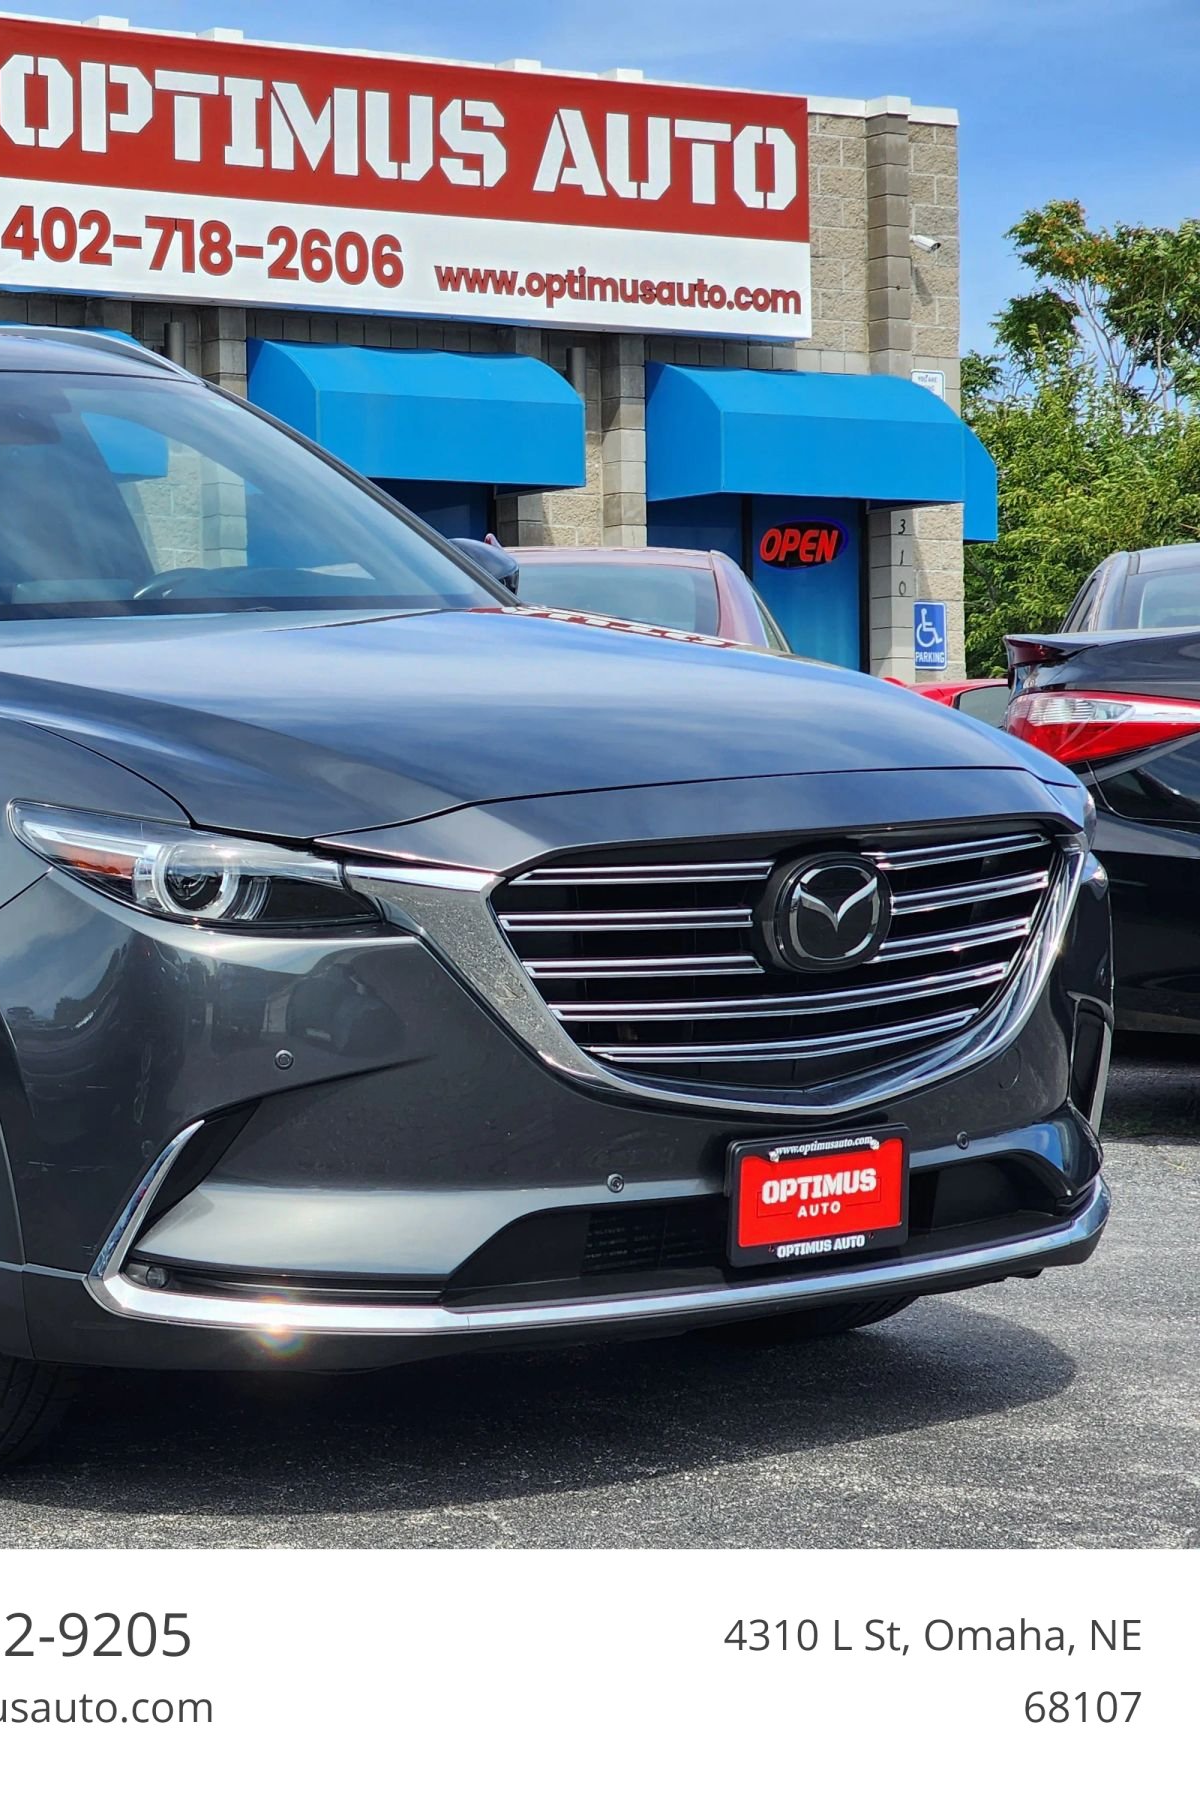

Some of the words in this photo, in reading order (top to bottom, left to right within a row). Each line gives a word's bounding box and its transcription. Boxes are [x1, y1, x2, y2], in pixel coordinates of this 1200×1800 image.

[533, 109, 797, 211] AUTO
[2, 205, 404, 288] 402-718-2606
[436, 266, 801, 314] www.optimusauto.com
[759, 528, 839, 564] OPEN
[915, 651, 945, 663] PARKING
[774, 1136, 873, 1155] www.optimusauto.com
[761, 1167, 877, 1205] OPTIMUS
[797, 1200, 841, 1218] AUTO
[776, 1238, 832, 1258] OPTIMUS
[833, 1234, 865, 1251] AUTO
